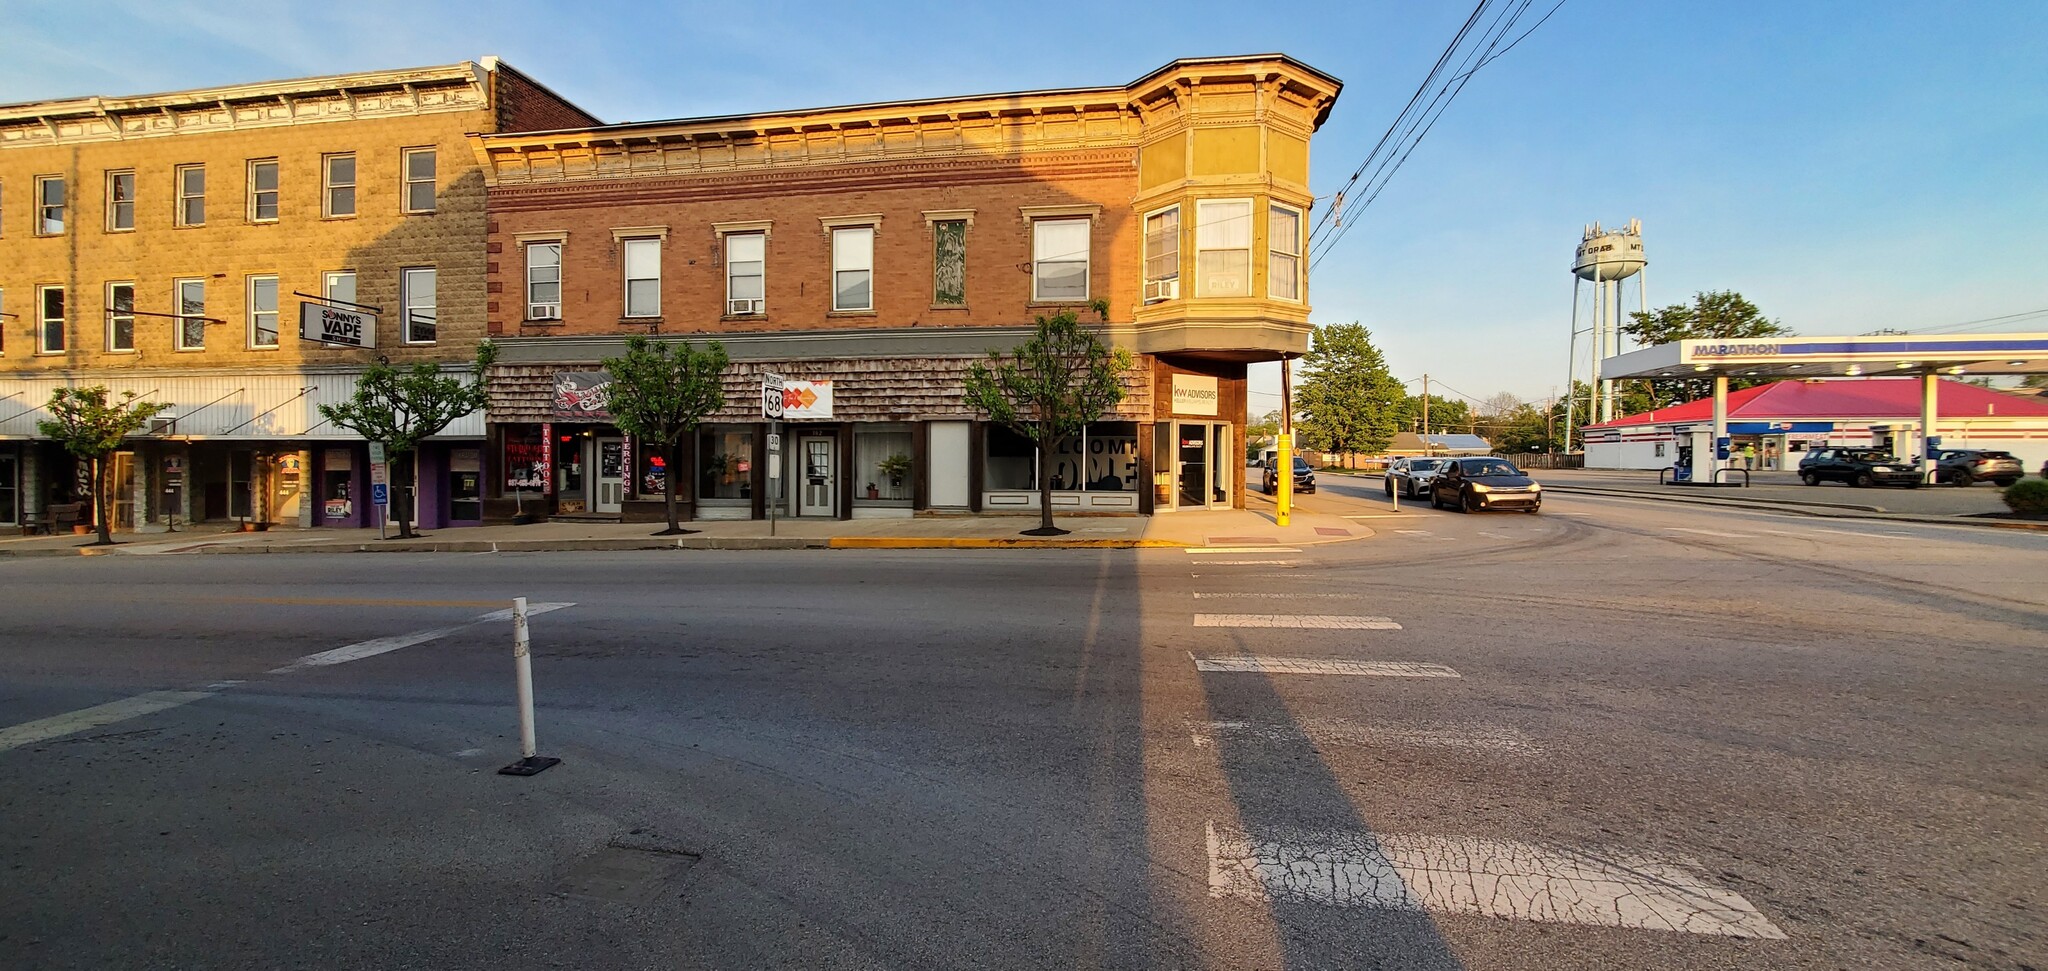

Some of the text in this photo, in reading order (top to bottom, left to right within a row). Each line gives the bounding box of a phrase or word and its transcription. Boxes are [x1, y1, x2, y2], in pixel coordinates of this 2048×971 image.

[1211, 281, 1235, 289] RILEY
[322, 309, 362, 325] SONNY'S
[322, 318, 362, 339] VAPE
[1694, 344, 1779, 355] MARATHON
[765, 374, 784, 390] NORTH
[1174, 385, 1216, 400] kw ADVISORS
[768, 394, 781, 413] 68
[770, 435, 779, 446] 30
[543, 428, 551, 486] TATTOOS
[623, 436, 631, 494] IERCINGS
[327, 507, 343, 515] RILEY
